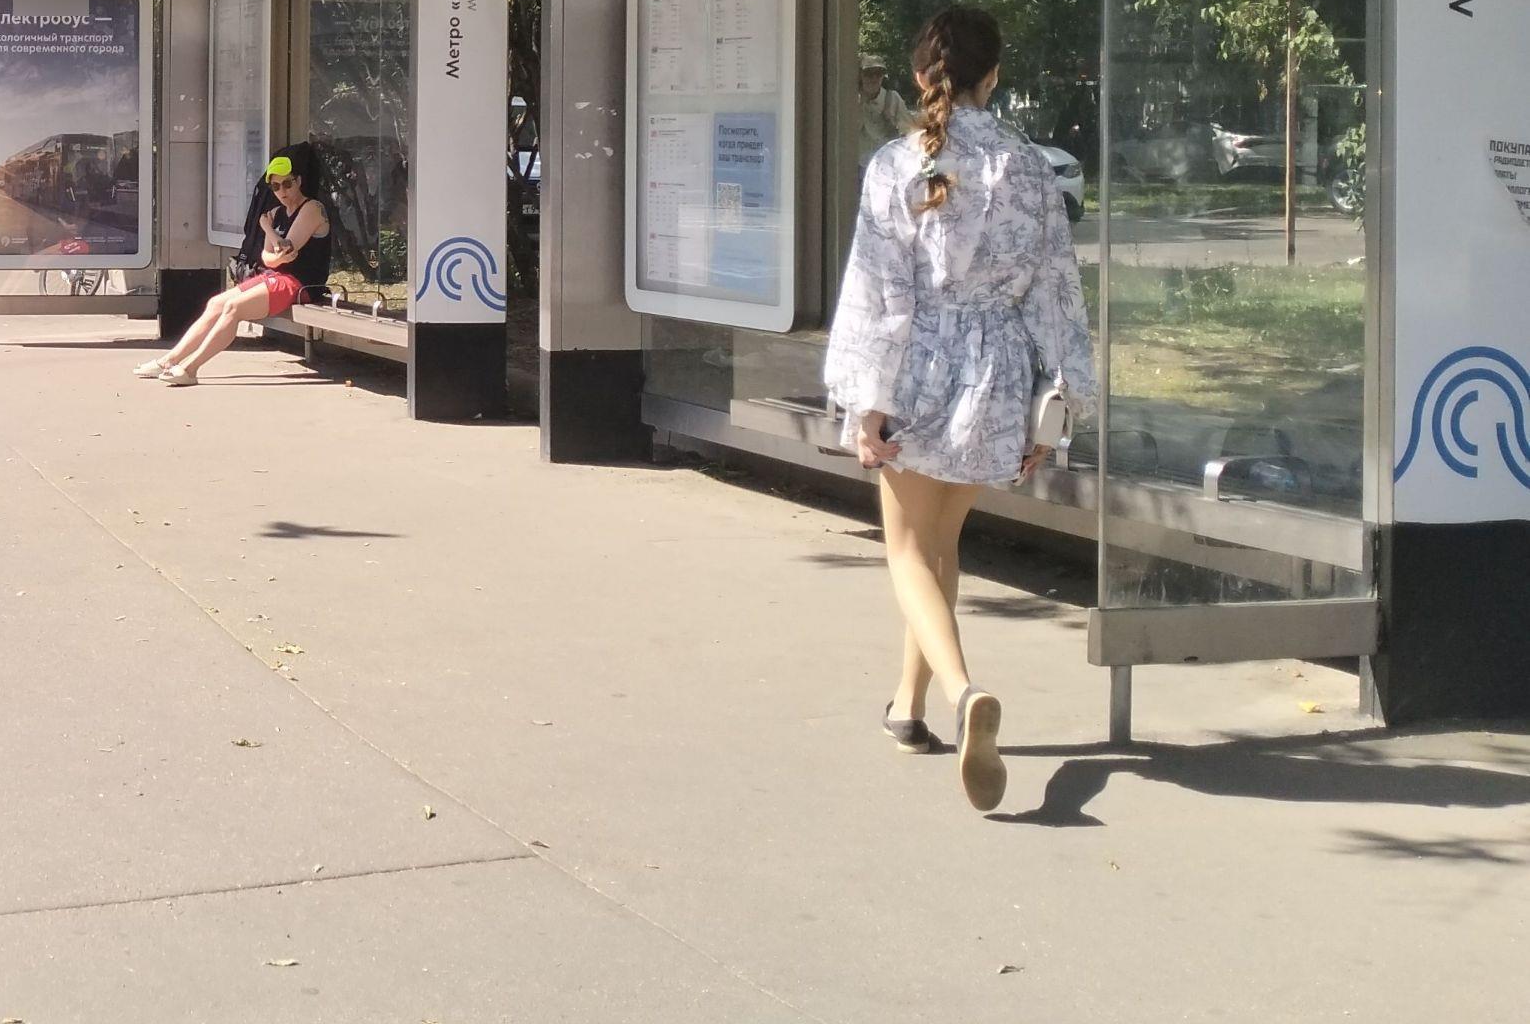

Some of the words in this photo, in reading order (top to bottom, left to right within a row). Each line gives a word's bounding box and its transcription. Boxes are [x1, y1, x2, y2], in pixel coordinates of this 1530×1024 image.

[60, 35, 113, 44] транспорт
[11, 45, 86, 55] современного
[88, 45, 125, 55] города
[446, 17, 463, 79] Метро
